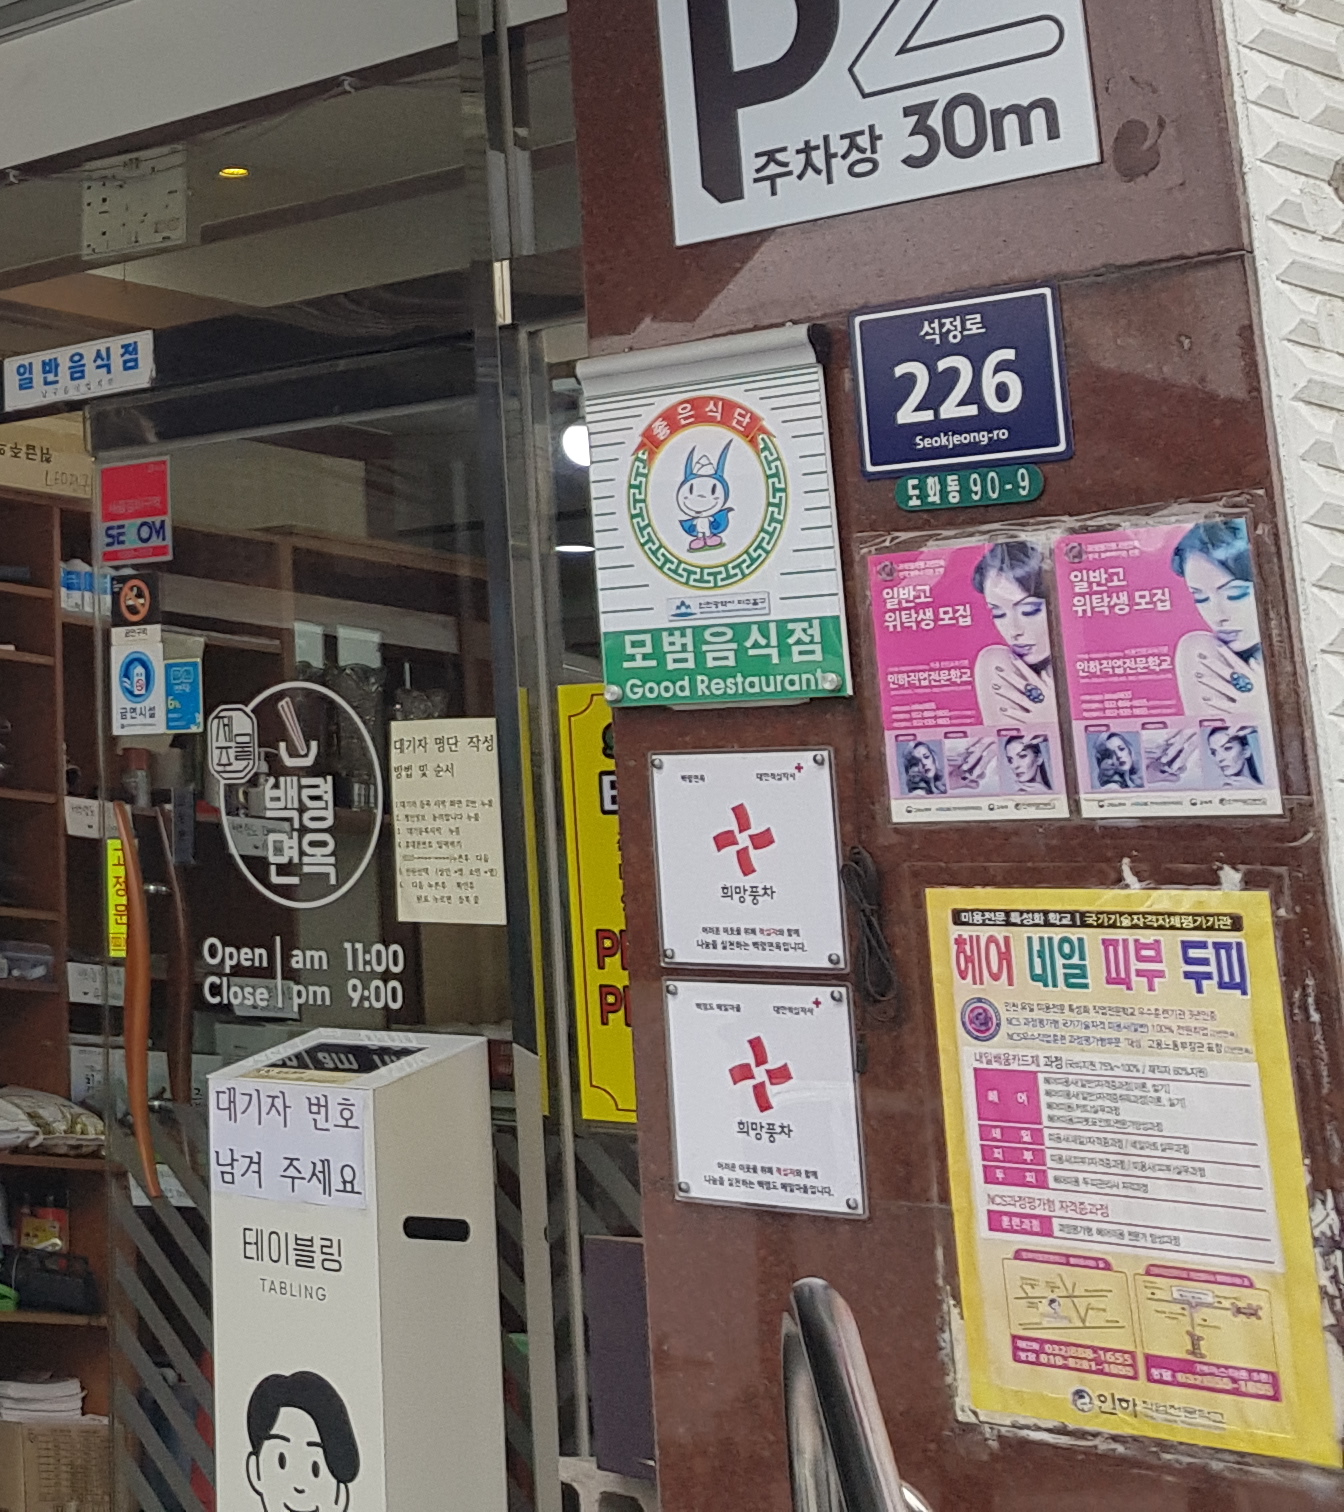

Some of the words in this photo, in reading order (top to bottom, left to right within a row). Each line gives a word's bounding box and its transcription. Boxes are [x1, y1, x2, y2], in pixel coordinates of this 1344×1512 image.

[752, 124, 883, 195] 주차장
[901, 92, 1061, 168] 30m
[919, 313, 986, 345] 석정로
[16, 341, 140, 391] 일반음식점
[893, 348, 1024, 425] 226
[915, 427, 1008, 450] Seokjeong-ro
[906, 473, 960, 508] 도화동
[969, 466, 1031, 499] 90-9
[105, 520, 166, 547] SECOM
[1070, 568, 1128, 592] 일반고
[882, 584, 933, 609] 일반고
[1072, 592, 1130, 617] 위탁생
[1133, 588, 1171, 611] 모집
[884, 608, 935, 632] 위탁생
[938, 604, 972, 626] 모집
[622, 624, 824, 671] 모범음식점
[887, 669, 972, 689] 인하직업전문학교
[1076, 656, 1173, 676] 인하직업전문학교
[625, 678, 691, 700] Good
[696, 669, 825, 695] Restaurant
[120, 705, 156, 719] 금연시설
[393, 738, 428, 754] 대기자
[434, 735, 460, 753] 명단
[467, 734, 494, 752] 작성
[394, 765, 412, 779] 방법
[419, 765, 428, 778] 및
[434, 763, 454, 778] 순서
[265, 775, 334, 830] 백령
[268, 831, 337, 885] 면옥
[721, 884, 776, 905] 희망풍차
[961, 911, 1007, 924] 미용전문
[1048, 913, 1072, 926] 학교
[204, 937, 268, 973] Open
[290, 946, 329, 971] am
[343, 942, 405, 974] 11:00
[954, 934, 1015, 987] 헤어
[1026, 936, 1090, 990] 네일
[1101, 938, 1166, 992] 피부
[1180, 939, 1249, 996] 두피
[204, 976, 268, 1007] Close
[291, 981, 331, 1013] pm
[348, 978, 404, 1010] 9:00
[214, 1087, 292, 1128] 대기자
[305, 1094, 360, 1132] 번호
[737, 1120, 793, 1143] 희망풍차
[214, 1148, 263, 1189] 남겨
[279, 1156, 362, 1196] 주세요
[243, 1226, 343, 1273] 테이블링
[259, 1277, 327, 1302] TABLING
[1096, 1392, 1138, 1418] 인하
